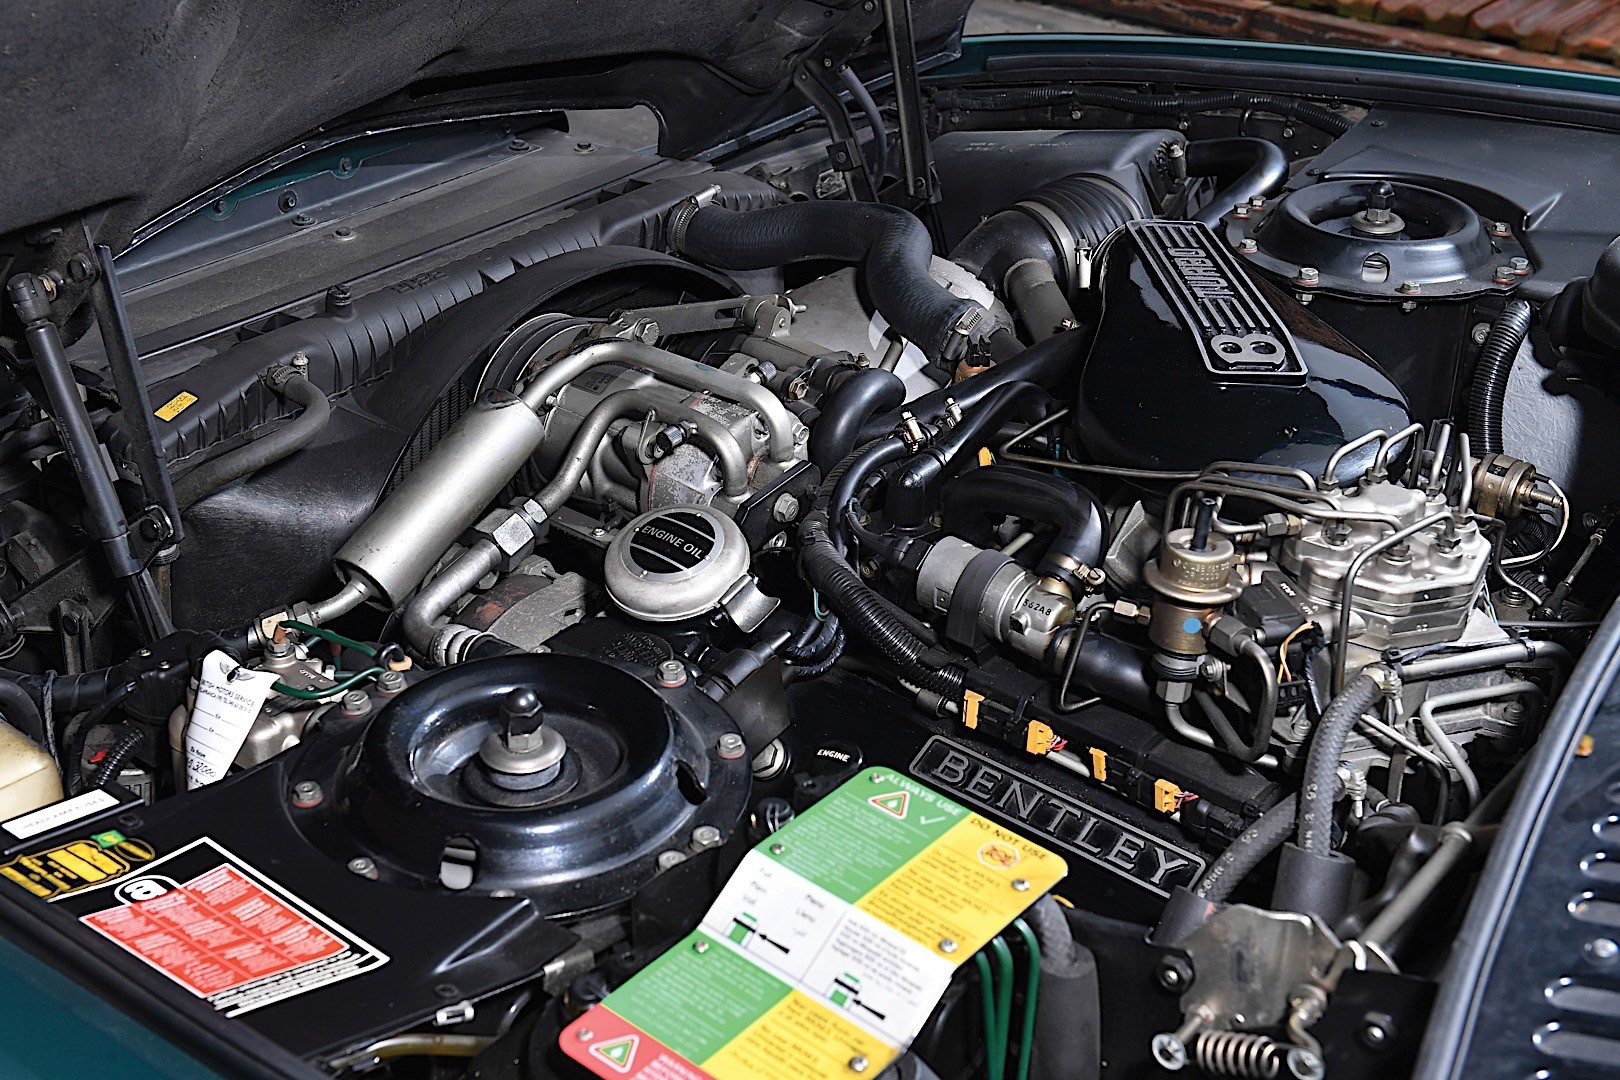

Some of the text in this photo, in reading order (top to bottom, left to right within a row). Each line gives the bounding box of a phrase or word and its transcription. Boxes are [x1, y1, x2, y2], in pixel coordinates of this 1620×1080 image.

[1167, 247, 1235, 300] TURBO
[641, 525, 702, 560] ENGINE OIL
[816, 748, 851, 763] ENGINE
[884, 773, 963, 817] ALWAYS USE
[932, 750, 1190, 885] BENTLEY
[970, 818, 1047, 860] DO NOT USE
